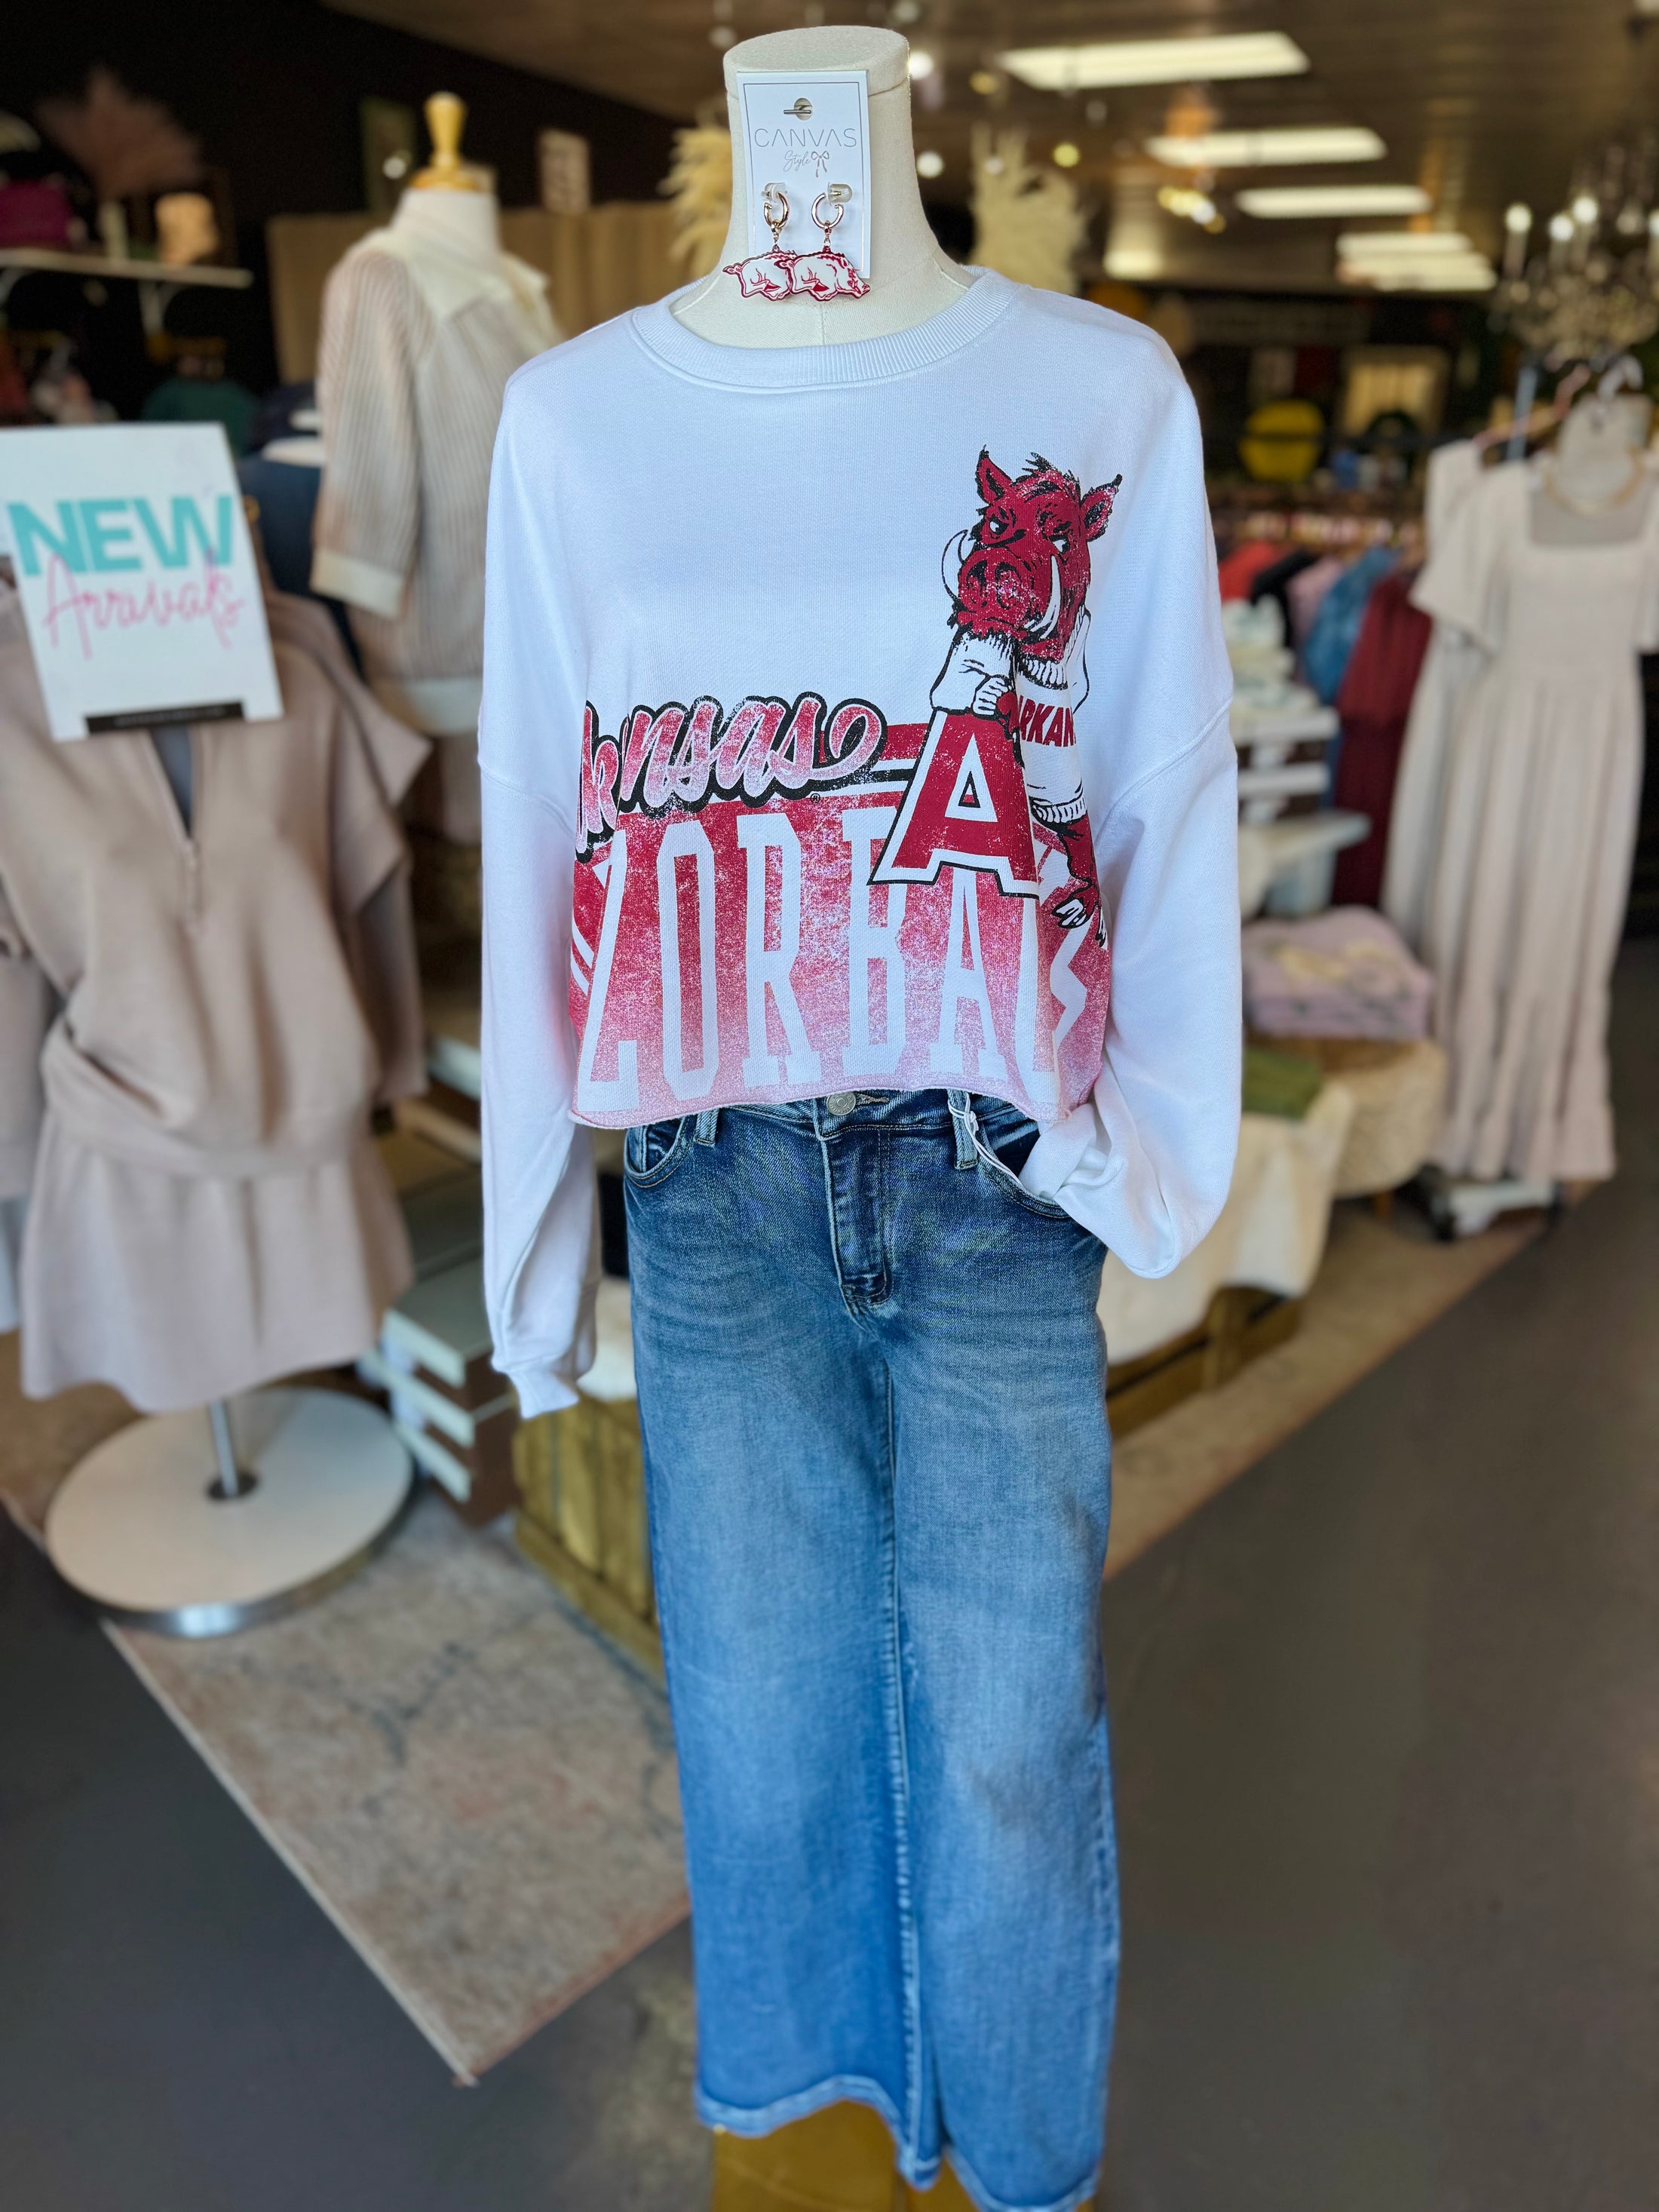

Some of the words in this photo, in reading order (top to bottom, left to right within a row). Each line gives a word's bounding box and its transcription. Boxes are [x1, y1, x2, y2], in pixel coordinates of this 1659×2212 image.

[754, 127, 857, 148] CANVAS
[783, 149, 811, 172] Style
[5, 494, 234, 577] NEW
[43, 549, 245, 661] Arrivals
